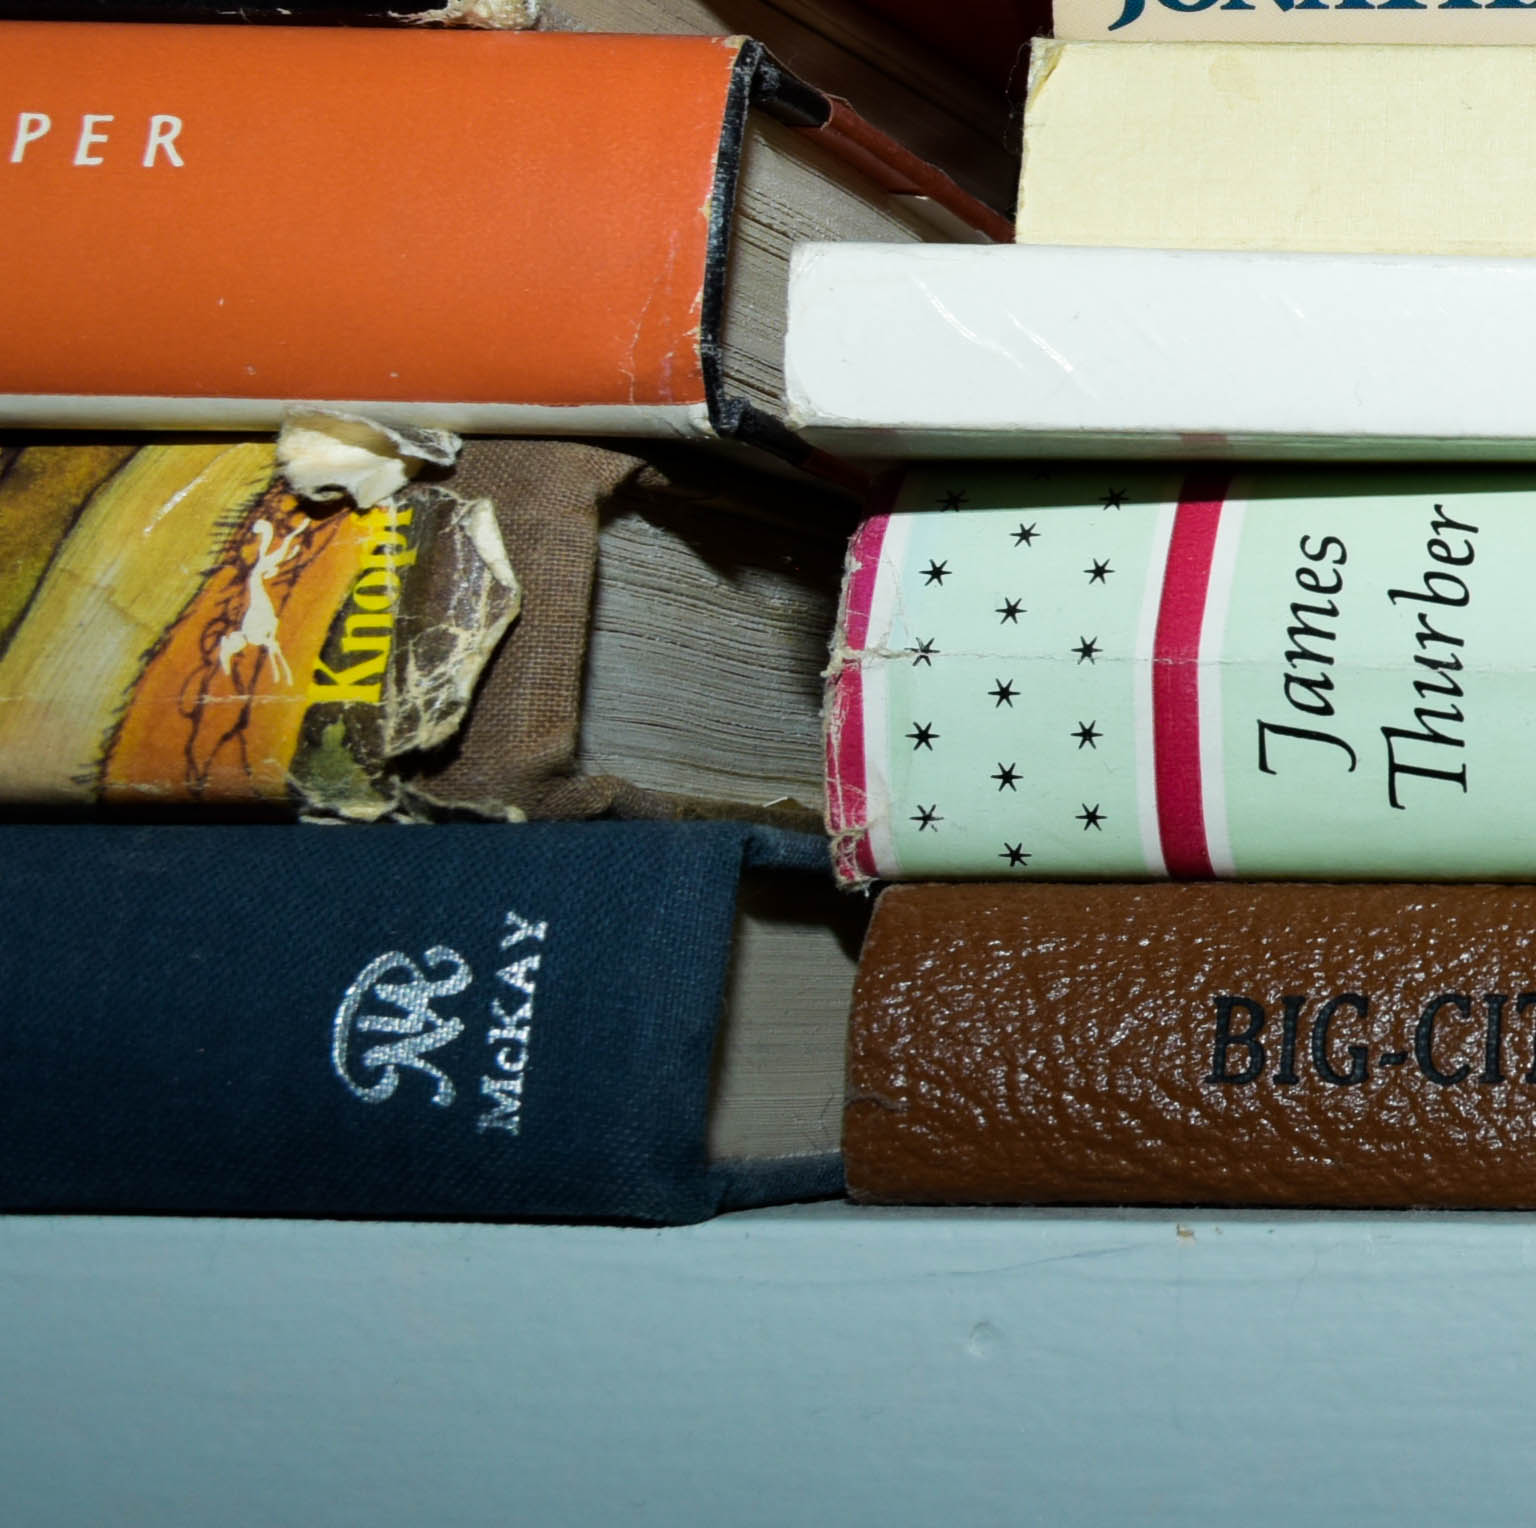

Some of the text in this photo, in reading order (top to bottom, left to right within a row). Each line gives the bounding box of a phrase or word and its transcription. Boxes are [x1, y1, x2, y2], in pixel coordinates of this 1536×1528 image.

[11, 113, 186, 168] PER
[307, 503, 417, 707] Knopf
[1257, 534, 1356, 775] James
[1380, 504, 1480, 811] Thurber
[478, 911, 547, 1136] McKAY
